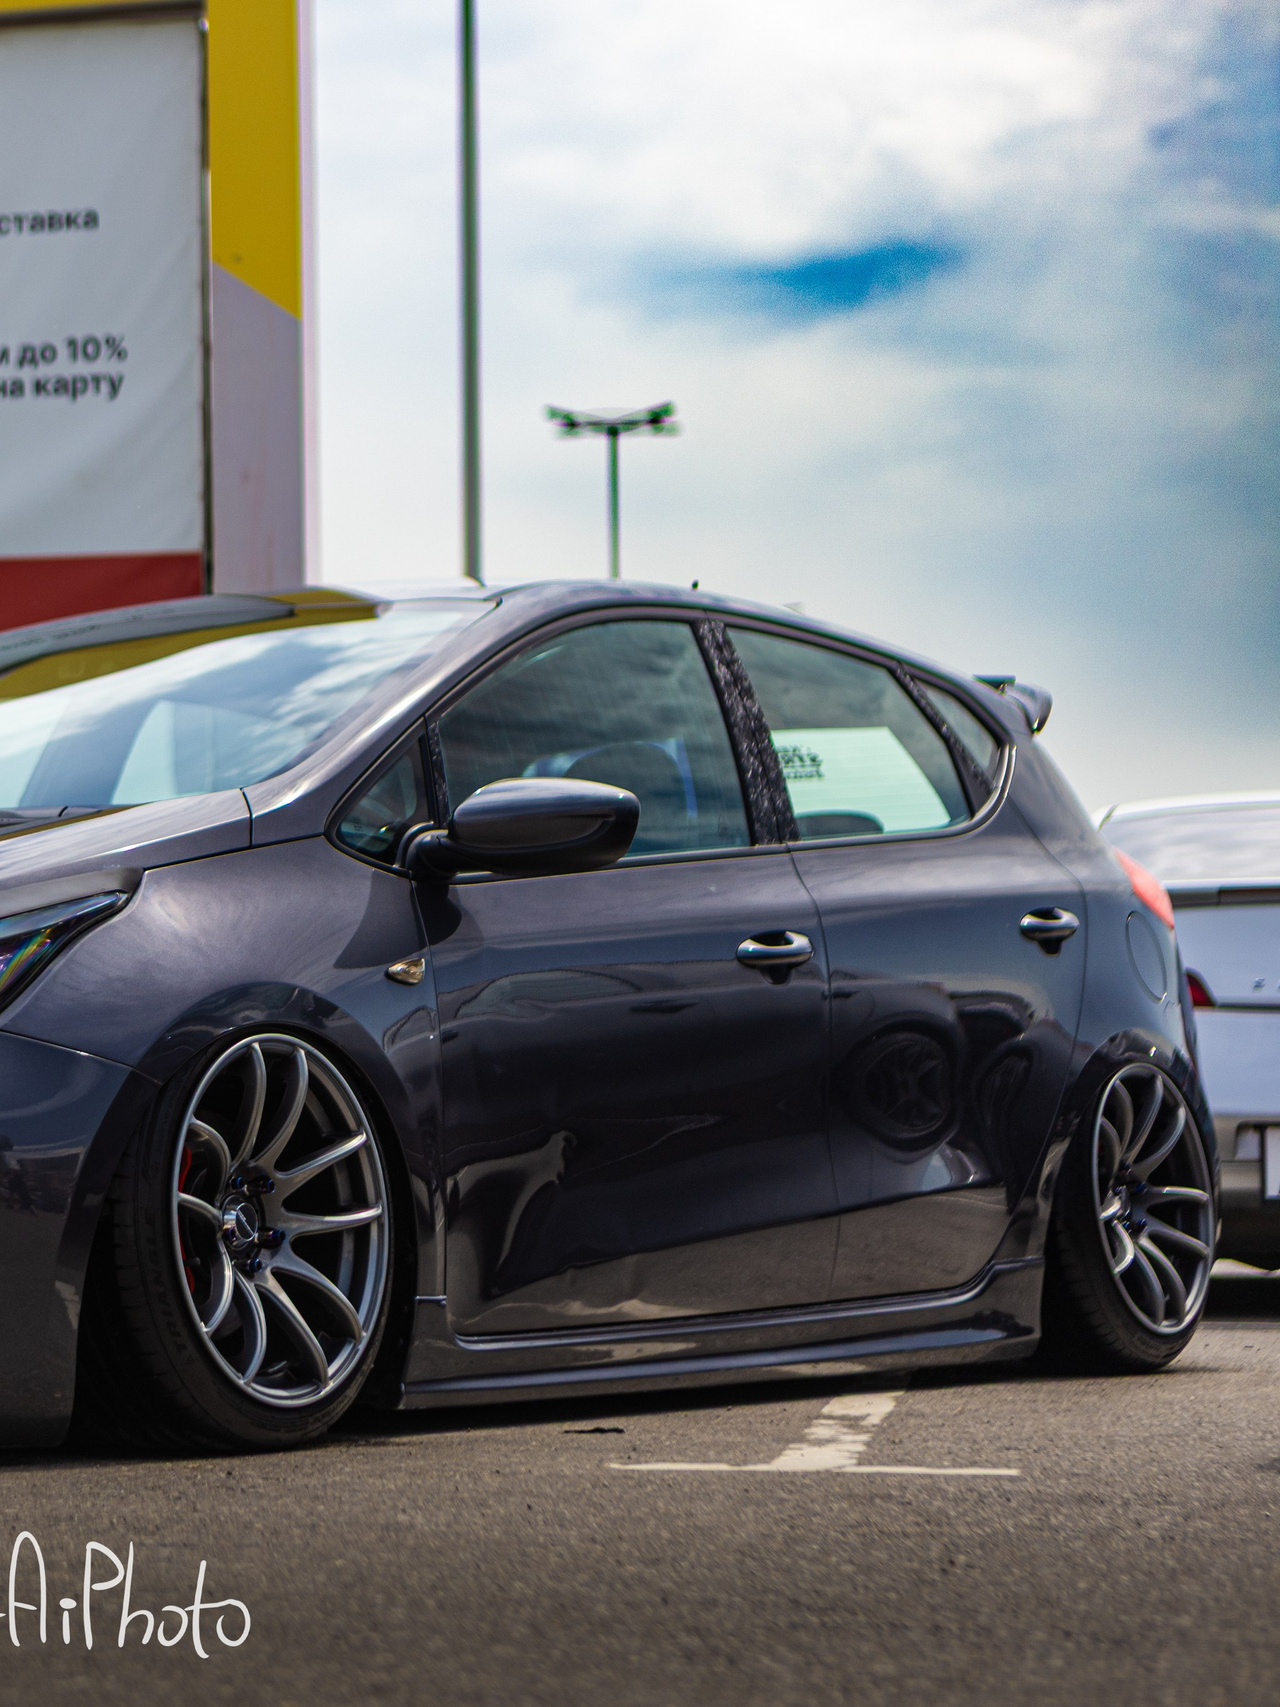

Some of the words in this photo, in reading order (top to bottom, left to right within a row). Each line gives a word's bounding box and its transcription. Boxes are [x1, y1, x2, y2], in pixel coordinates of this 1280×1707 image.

[17, 344, 60, 371] до
[66, 335, 130, 364] 10%
[32, 374, 125, 403] карту
